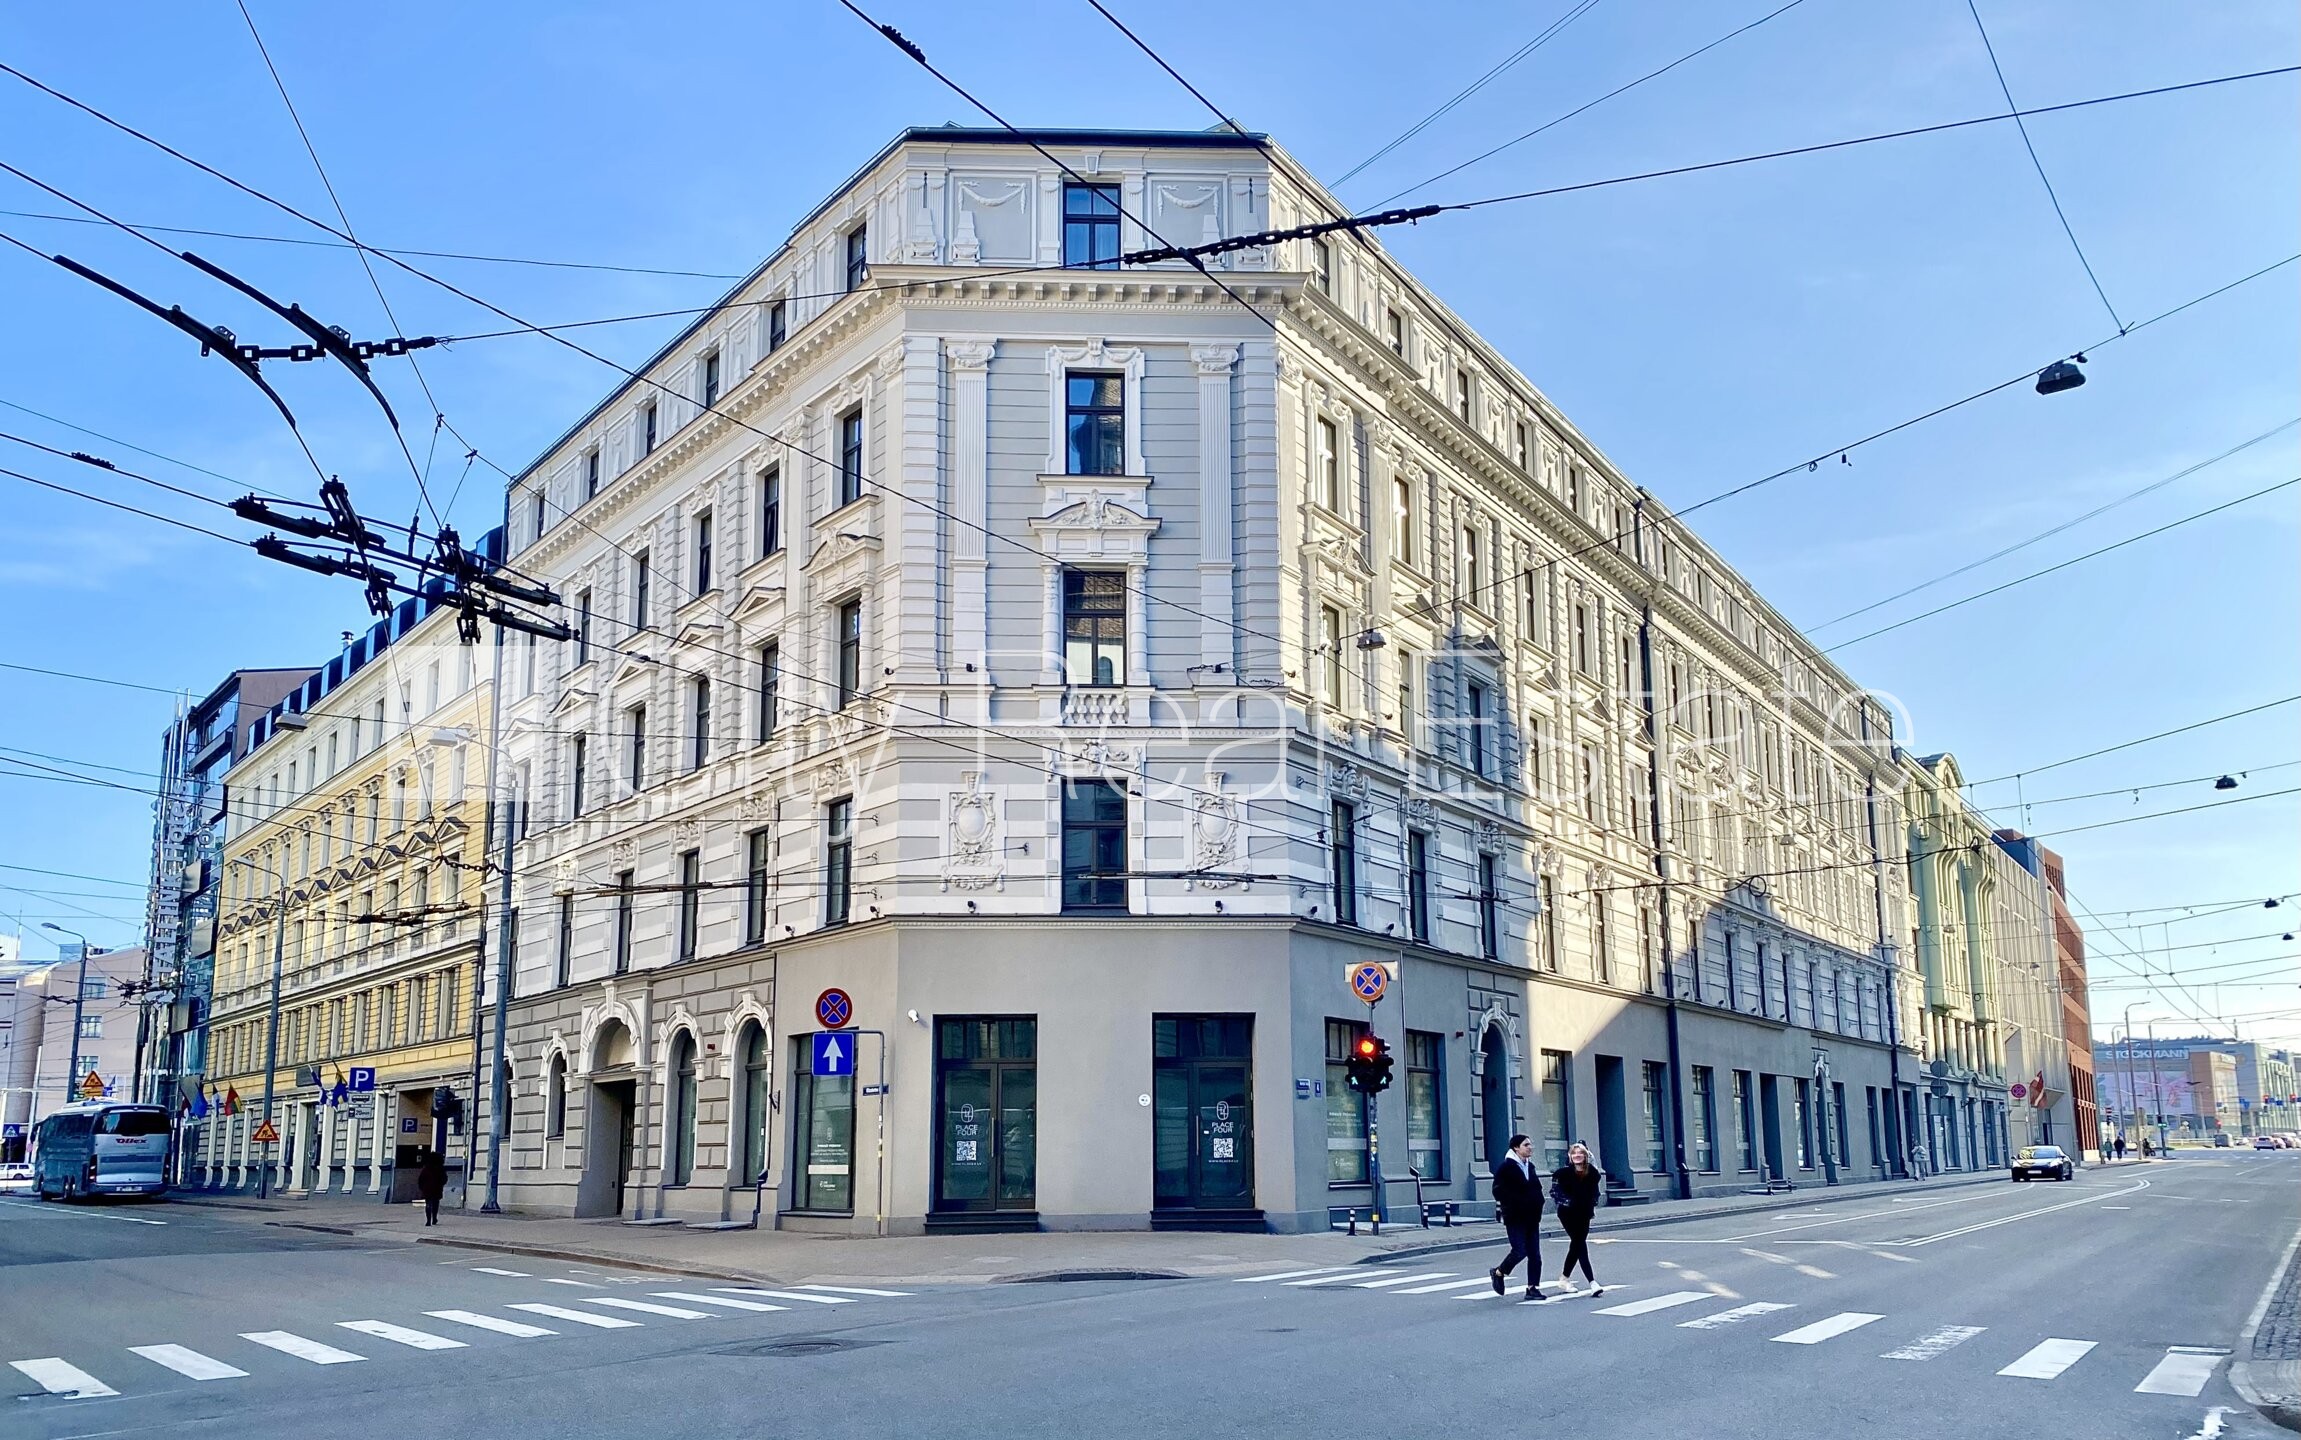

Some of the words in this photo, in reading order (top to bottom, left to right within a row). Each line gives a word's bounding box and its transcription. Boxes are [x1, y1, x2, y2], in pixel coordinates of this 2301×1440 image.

[152, 873, 183, 980] TALLINK
[2105, 1049, 2189, 1060] STOCKMANN
[355, 1070, 369, 1088] P
[405, 1119, 415, 1131] P
